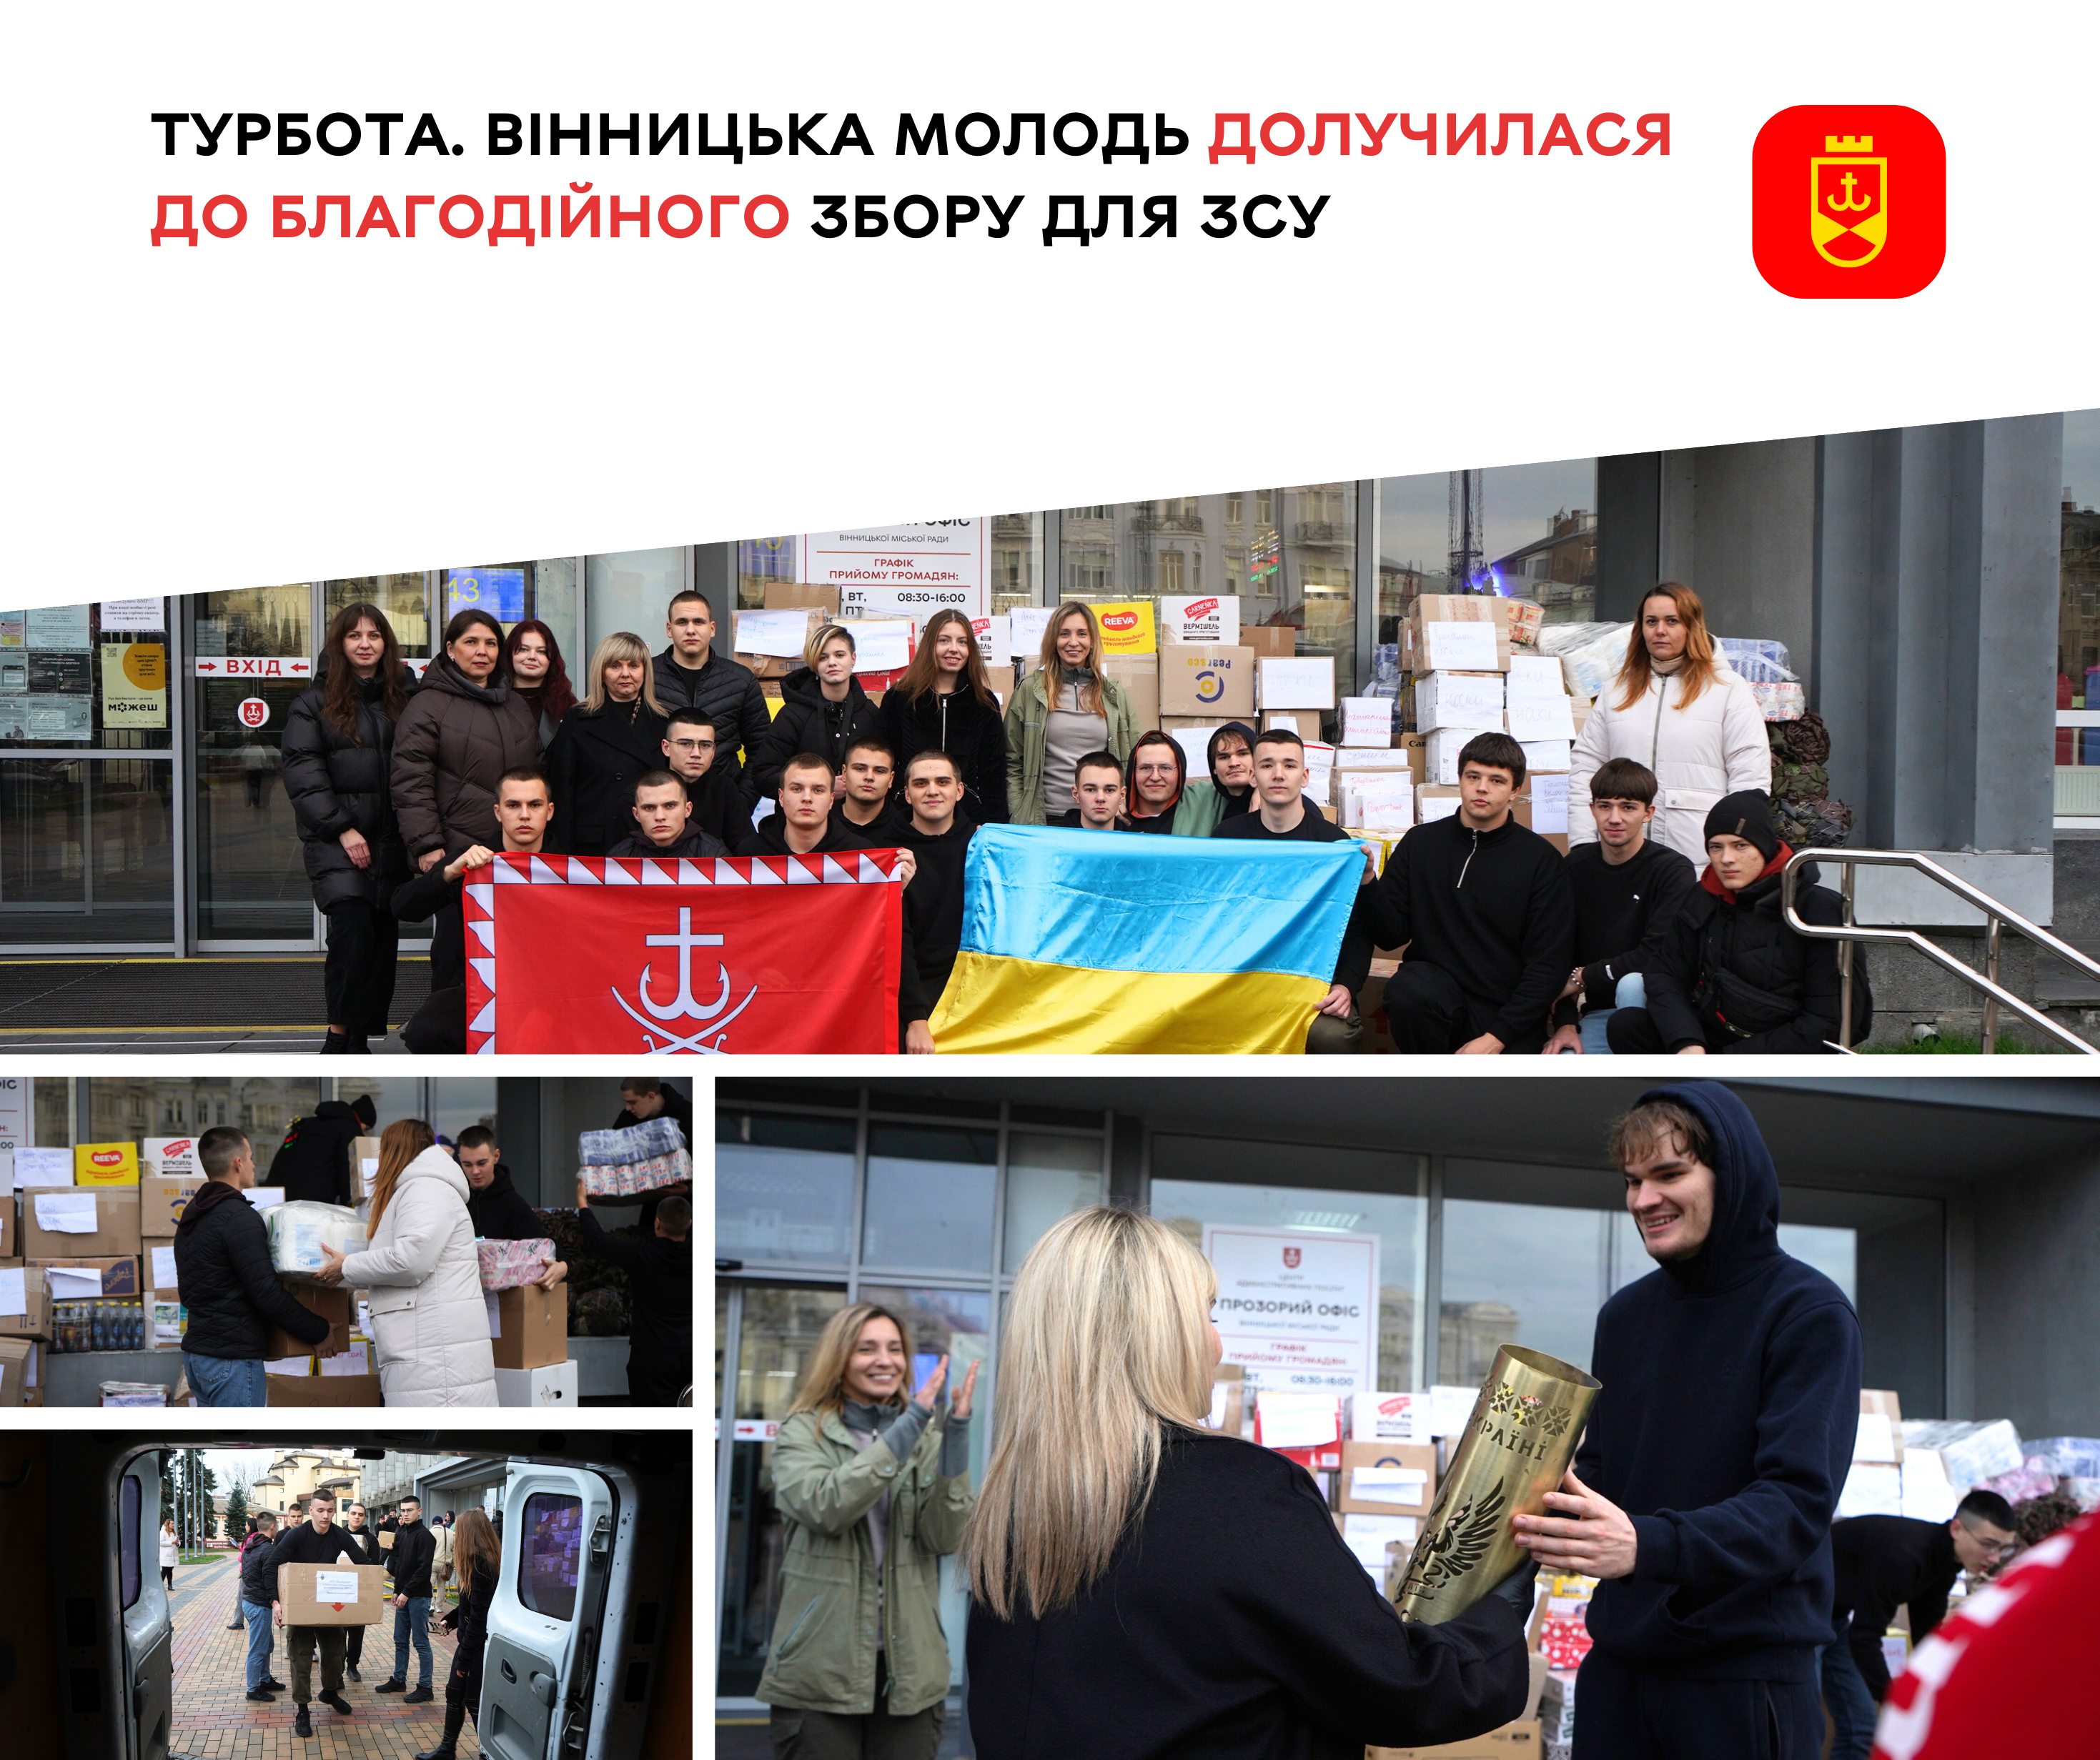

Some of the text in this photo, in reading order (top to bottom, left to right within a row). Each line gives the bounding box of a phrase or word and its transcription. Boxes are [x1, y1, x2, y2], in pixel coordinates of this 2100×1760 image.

[874, 559, 913, 568] ГРАФІК
[829, 569, 959, 581] ПРИЙОМУ ГРОМАДЯН:
[848, 592, 966, 602] ВТ, 08:30-16:00
[1104, 616, 1135, 626] REEVA
[227, 660, 282, 676] ВХІД
[94, 1154, 120, 1163] REEVA
[1219, 1297, 1360, 1318] ПРОЗОРИЙ ОФІС
